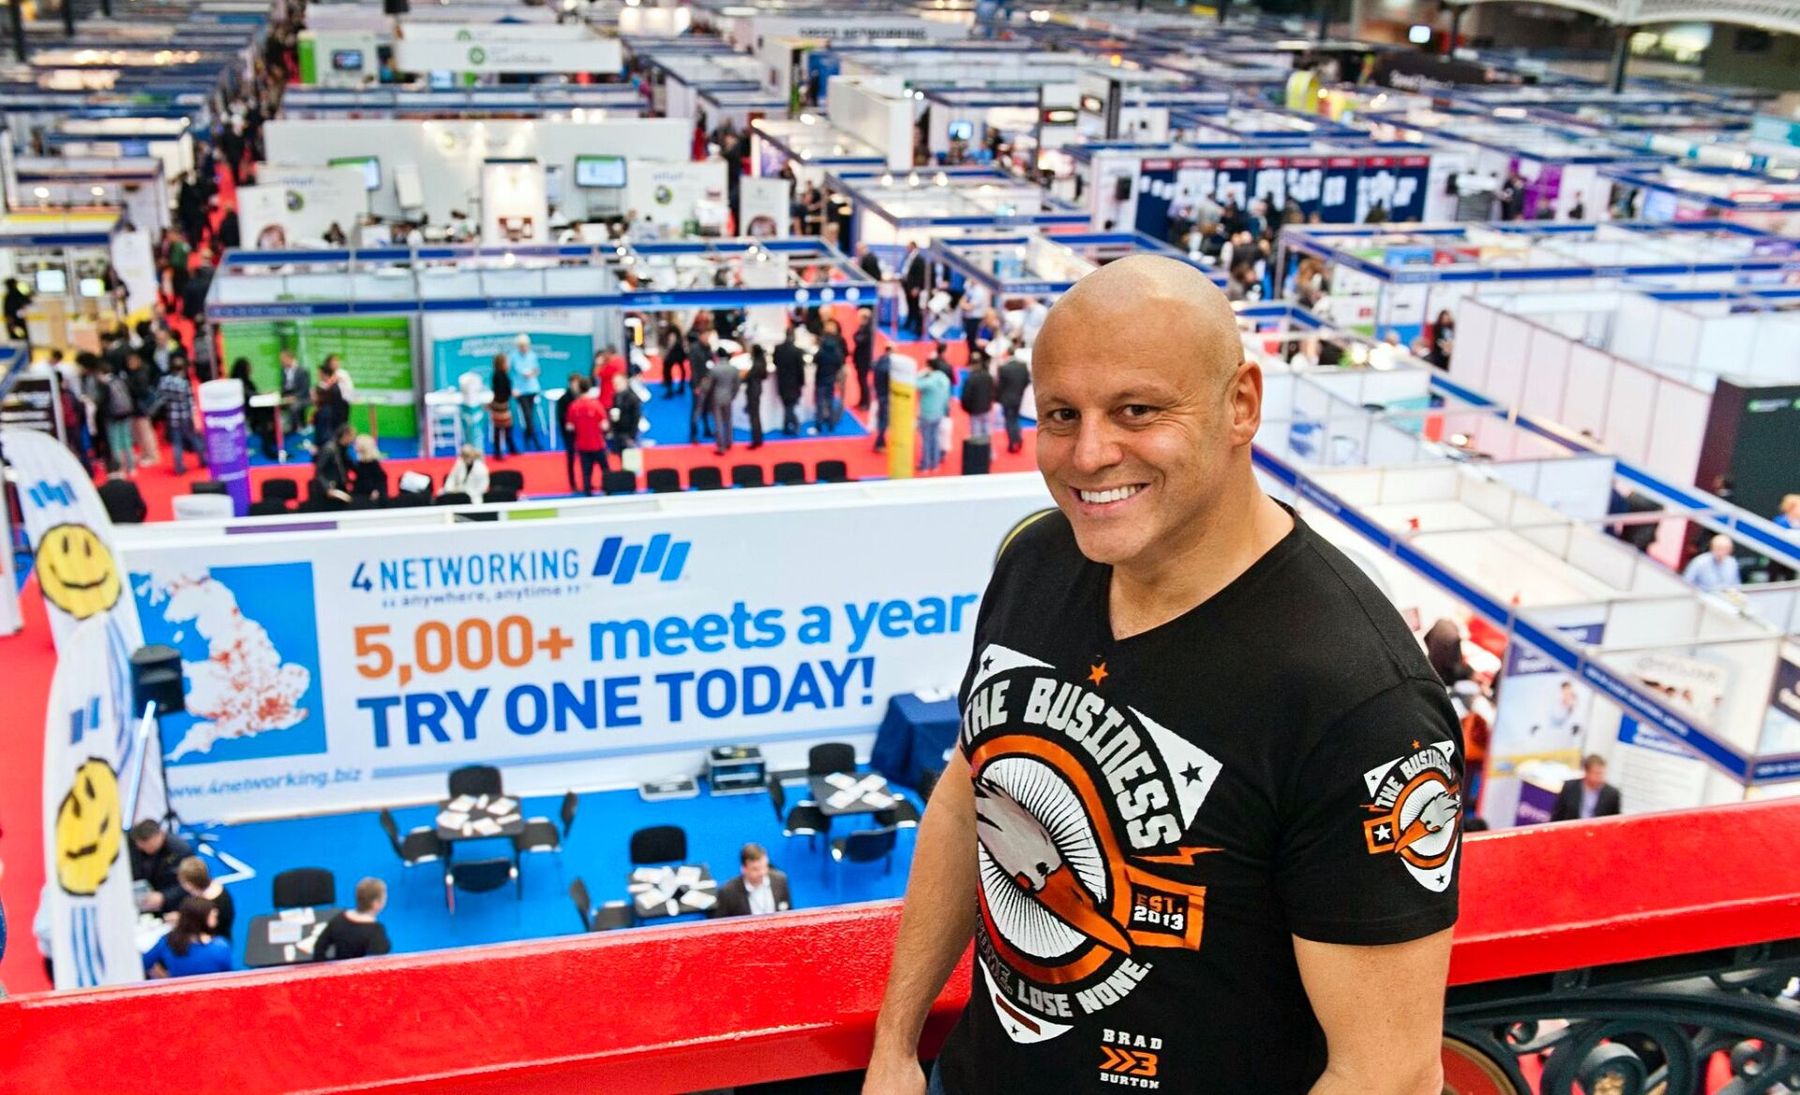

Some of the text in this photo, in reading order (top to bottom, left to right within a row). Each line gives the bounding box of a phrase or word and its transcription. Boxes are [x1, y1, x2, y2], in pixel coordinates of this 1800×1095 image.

[353, 594, 978, 687] 5,000+ meets a year
[356, 656, 875, 748] TRY ONE TODAY!
[961, 677, 1182, 849] THE BUSINESS
[1374, 776, 1405, 808] THE
[1133, 905, 1184, 930] 2013
[1136, 892, 1183, 914] EST.
[1017, 957, 1154, 1018] LOSE NONE.
[1102, 1028, 1163, 1050] BRAD
[1100, 1072, 1160, 1089] BURTON
